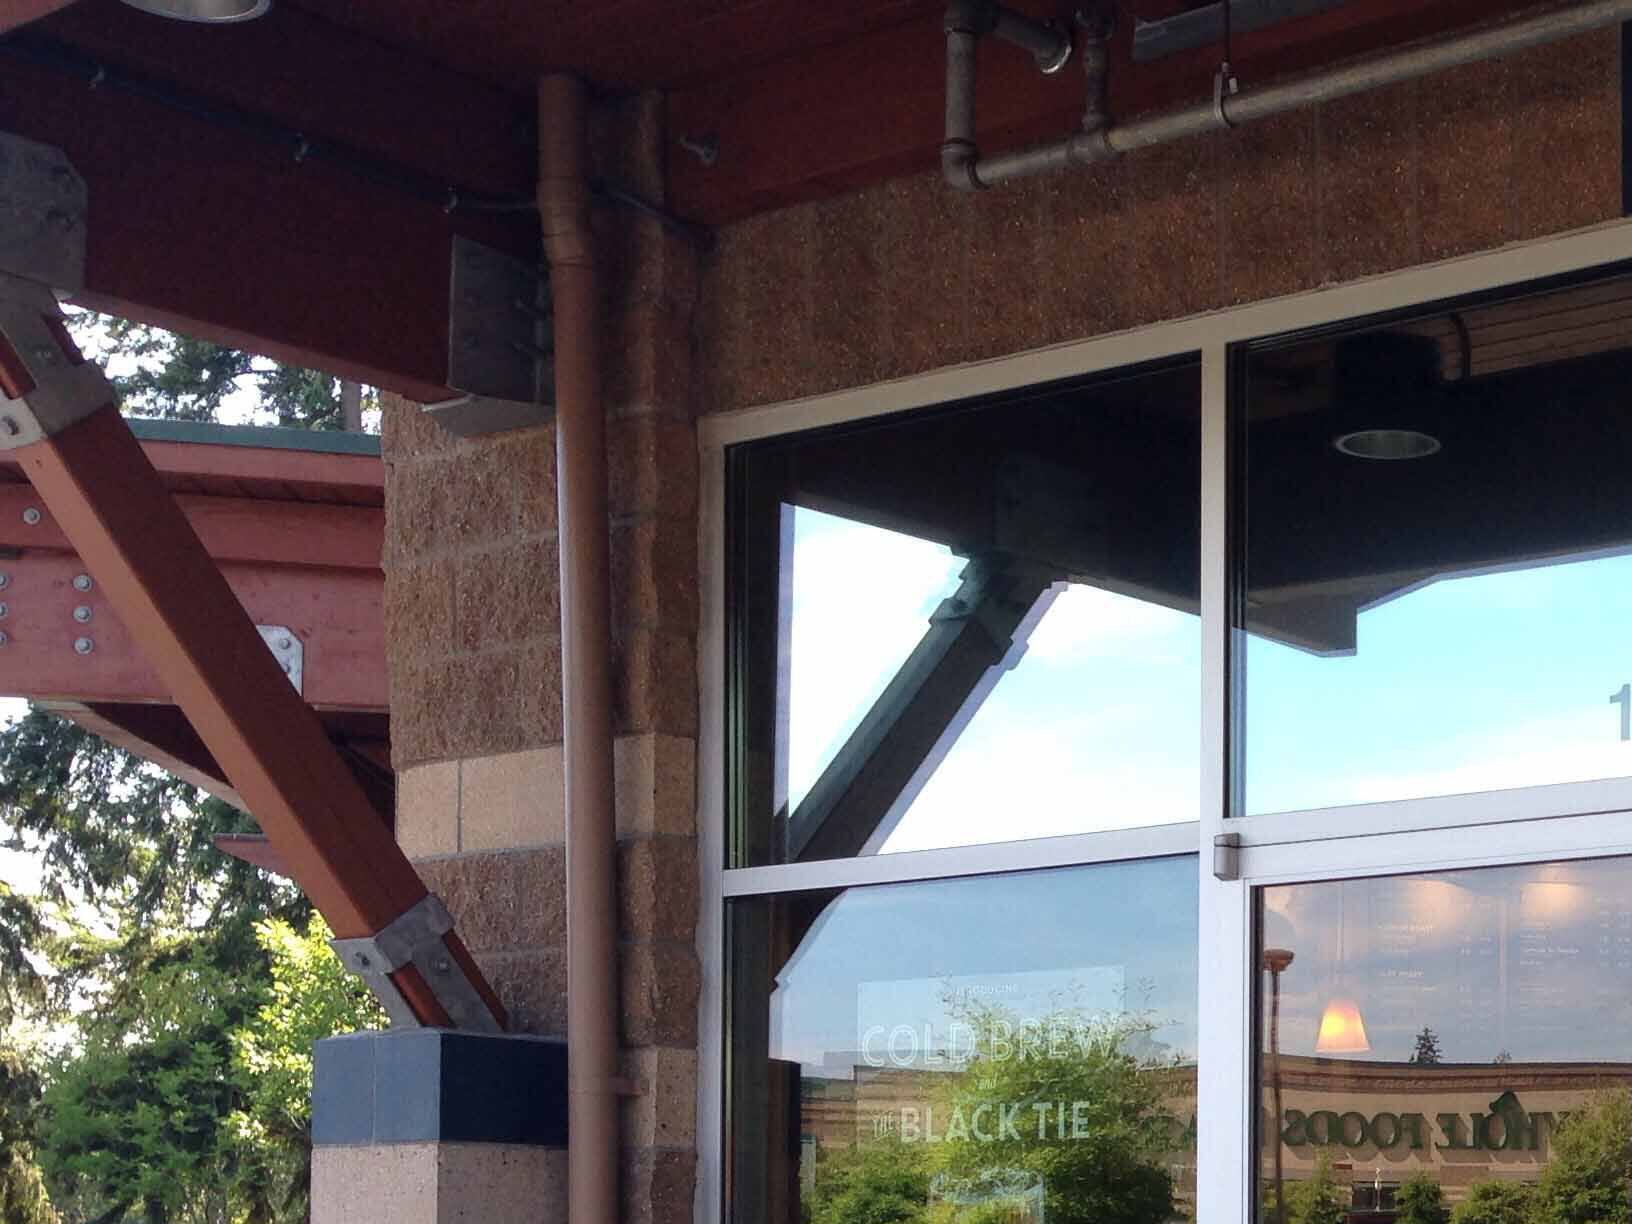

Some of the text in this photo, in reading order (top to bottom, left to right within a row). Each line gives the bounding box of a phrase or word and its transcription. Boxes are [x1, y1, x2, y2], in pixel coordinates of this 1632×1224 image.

[861, 1013, 1119, 1067] COLD BREW
[900, 1103, 1024, 1143] BLACK
[1032, 1100, 1091, 1140] TIE
